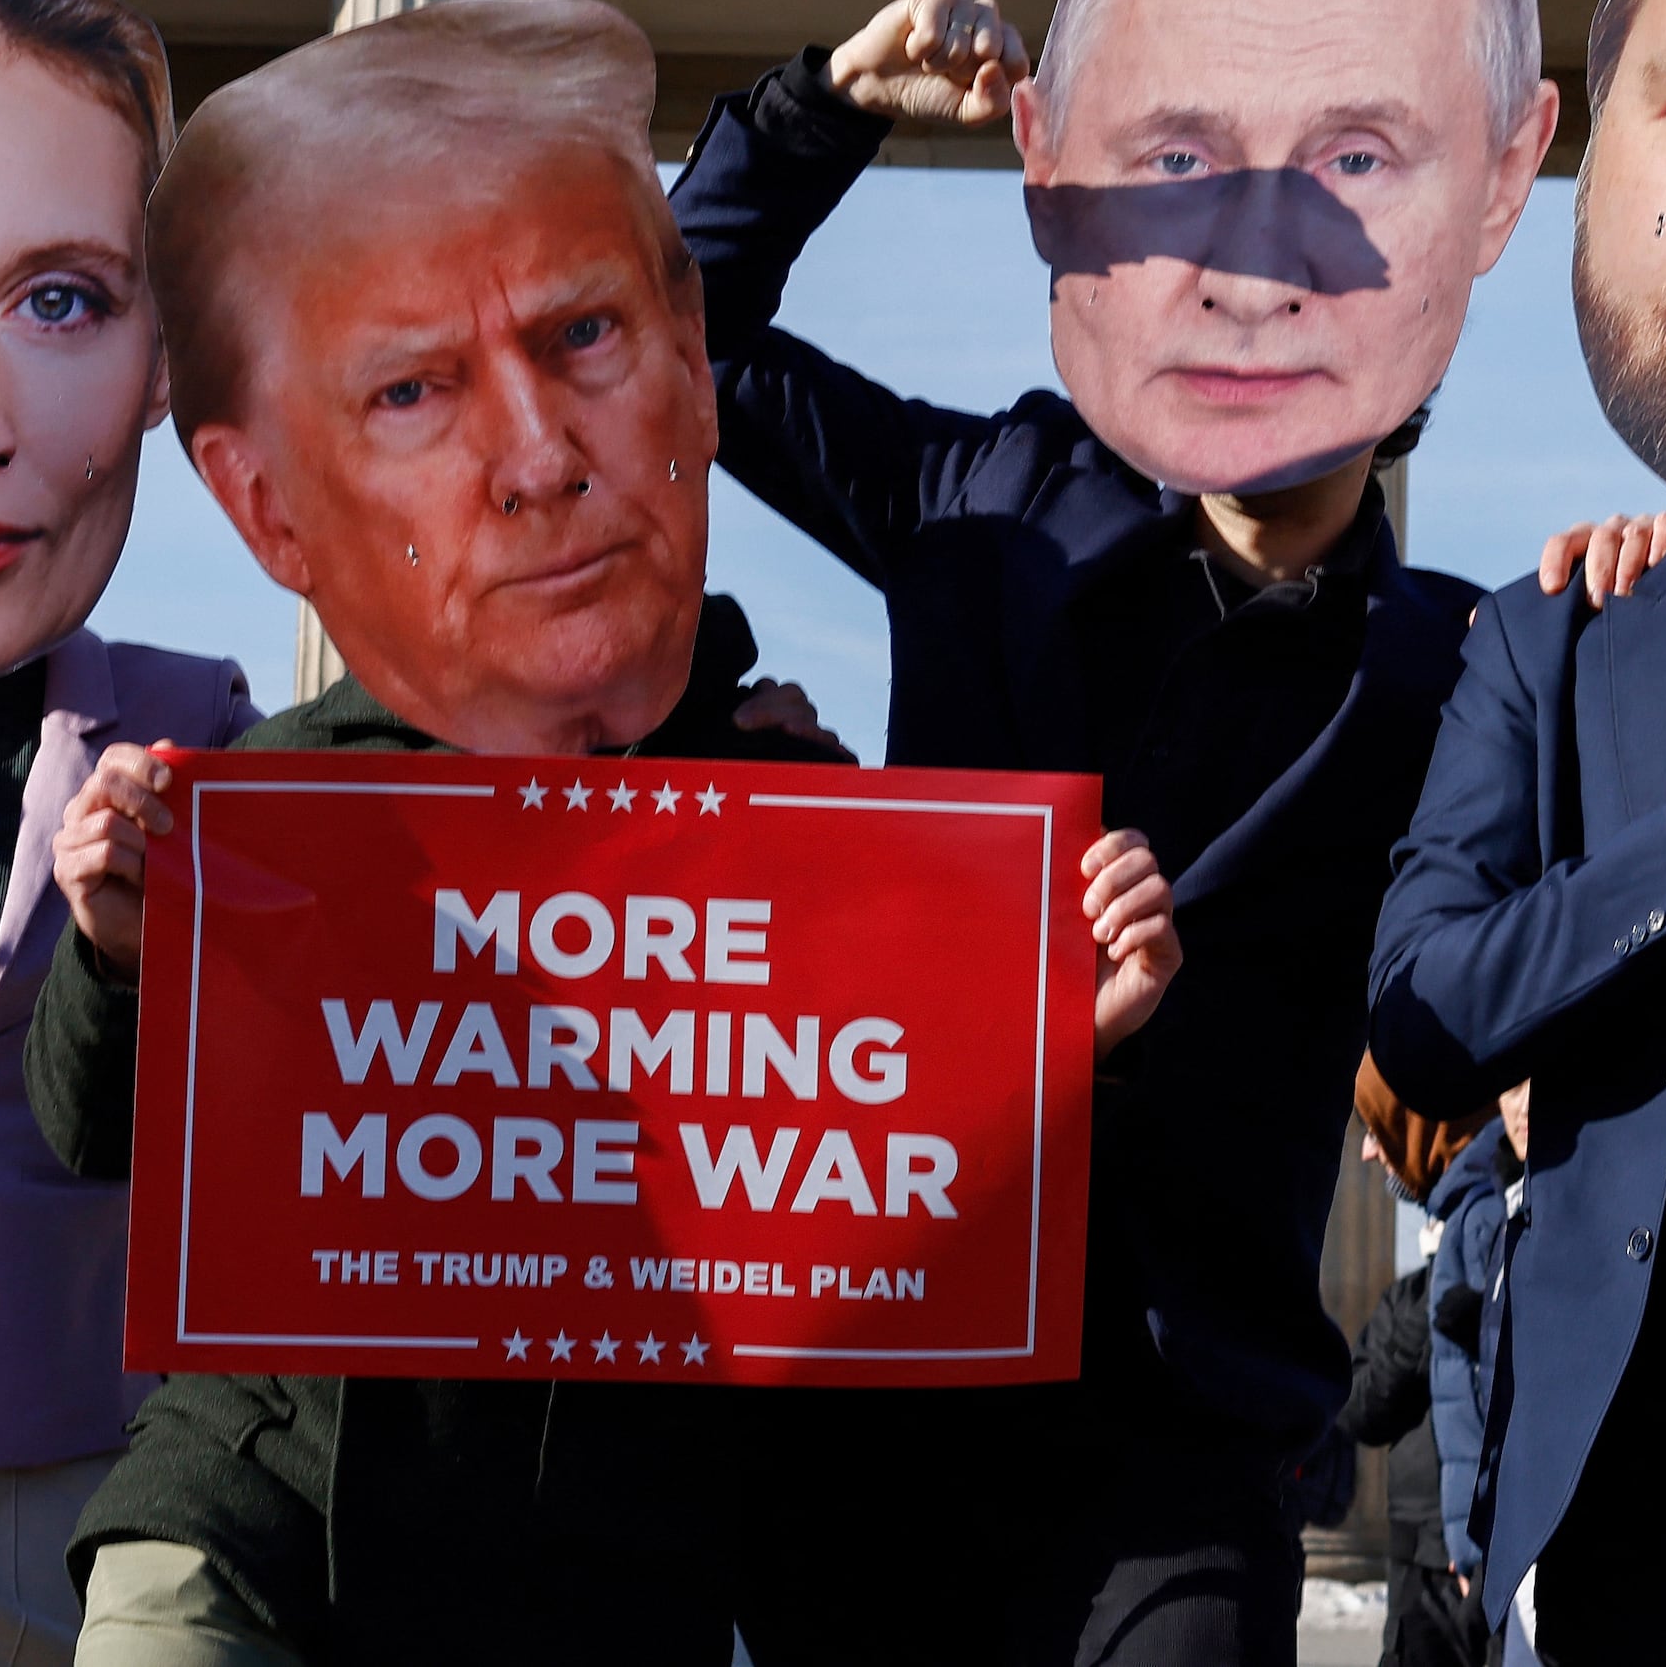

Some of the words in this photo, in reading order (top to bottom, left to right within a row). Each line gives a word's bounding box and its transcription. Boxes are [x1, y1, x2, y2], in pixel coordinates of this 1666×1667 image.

[434, 890, 771, 984] MORE
[322, 1000, 907, 1103] WARMING
[301, 1113, 638, 1203] MORE
[679, 1124, 958, 1218] WAR
[313, 1251, 398, 1283] THE
[414, 1253, 567, 1286] TRUMP
[584, 1257, 613, 1288] &
[630, 1258, 795, 1295] WEIDEL
[811, 1266, 924, 1299] PLAN
